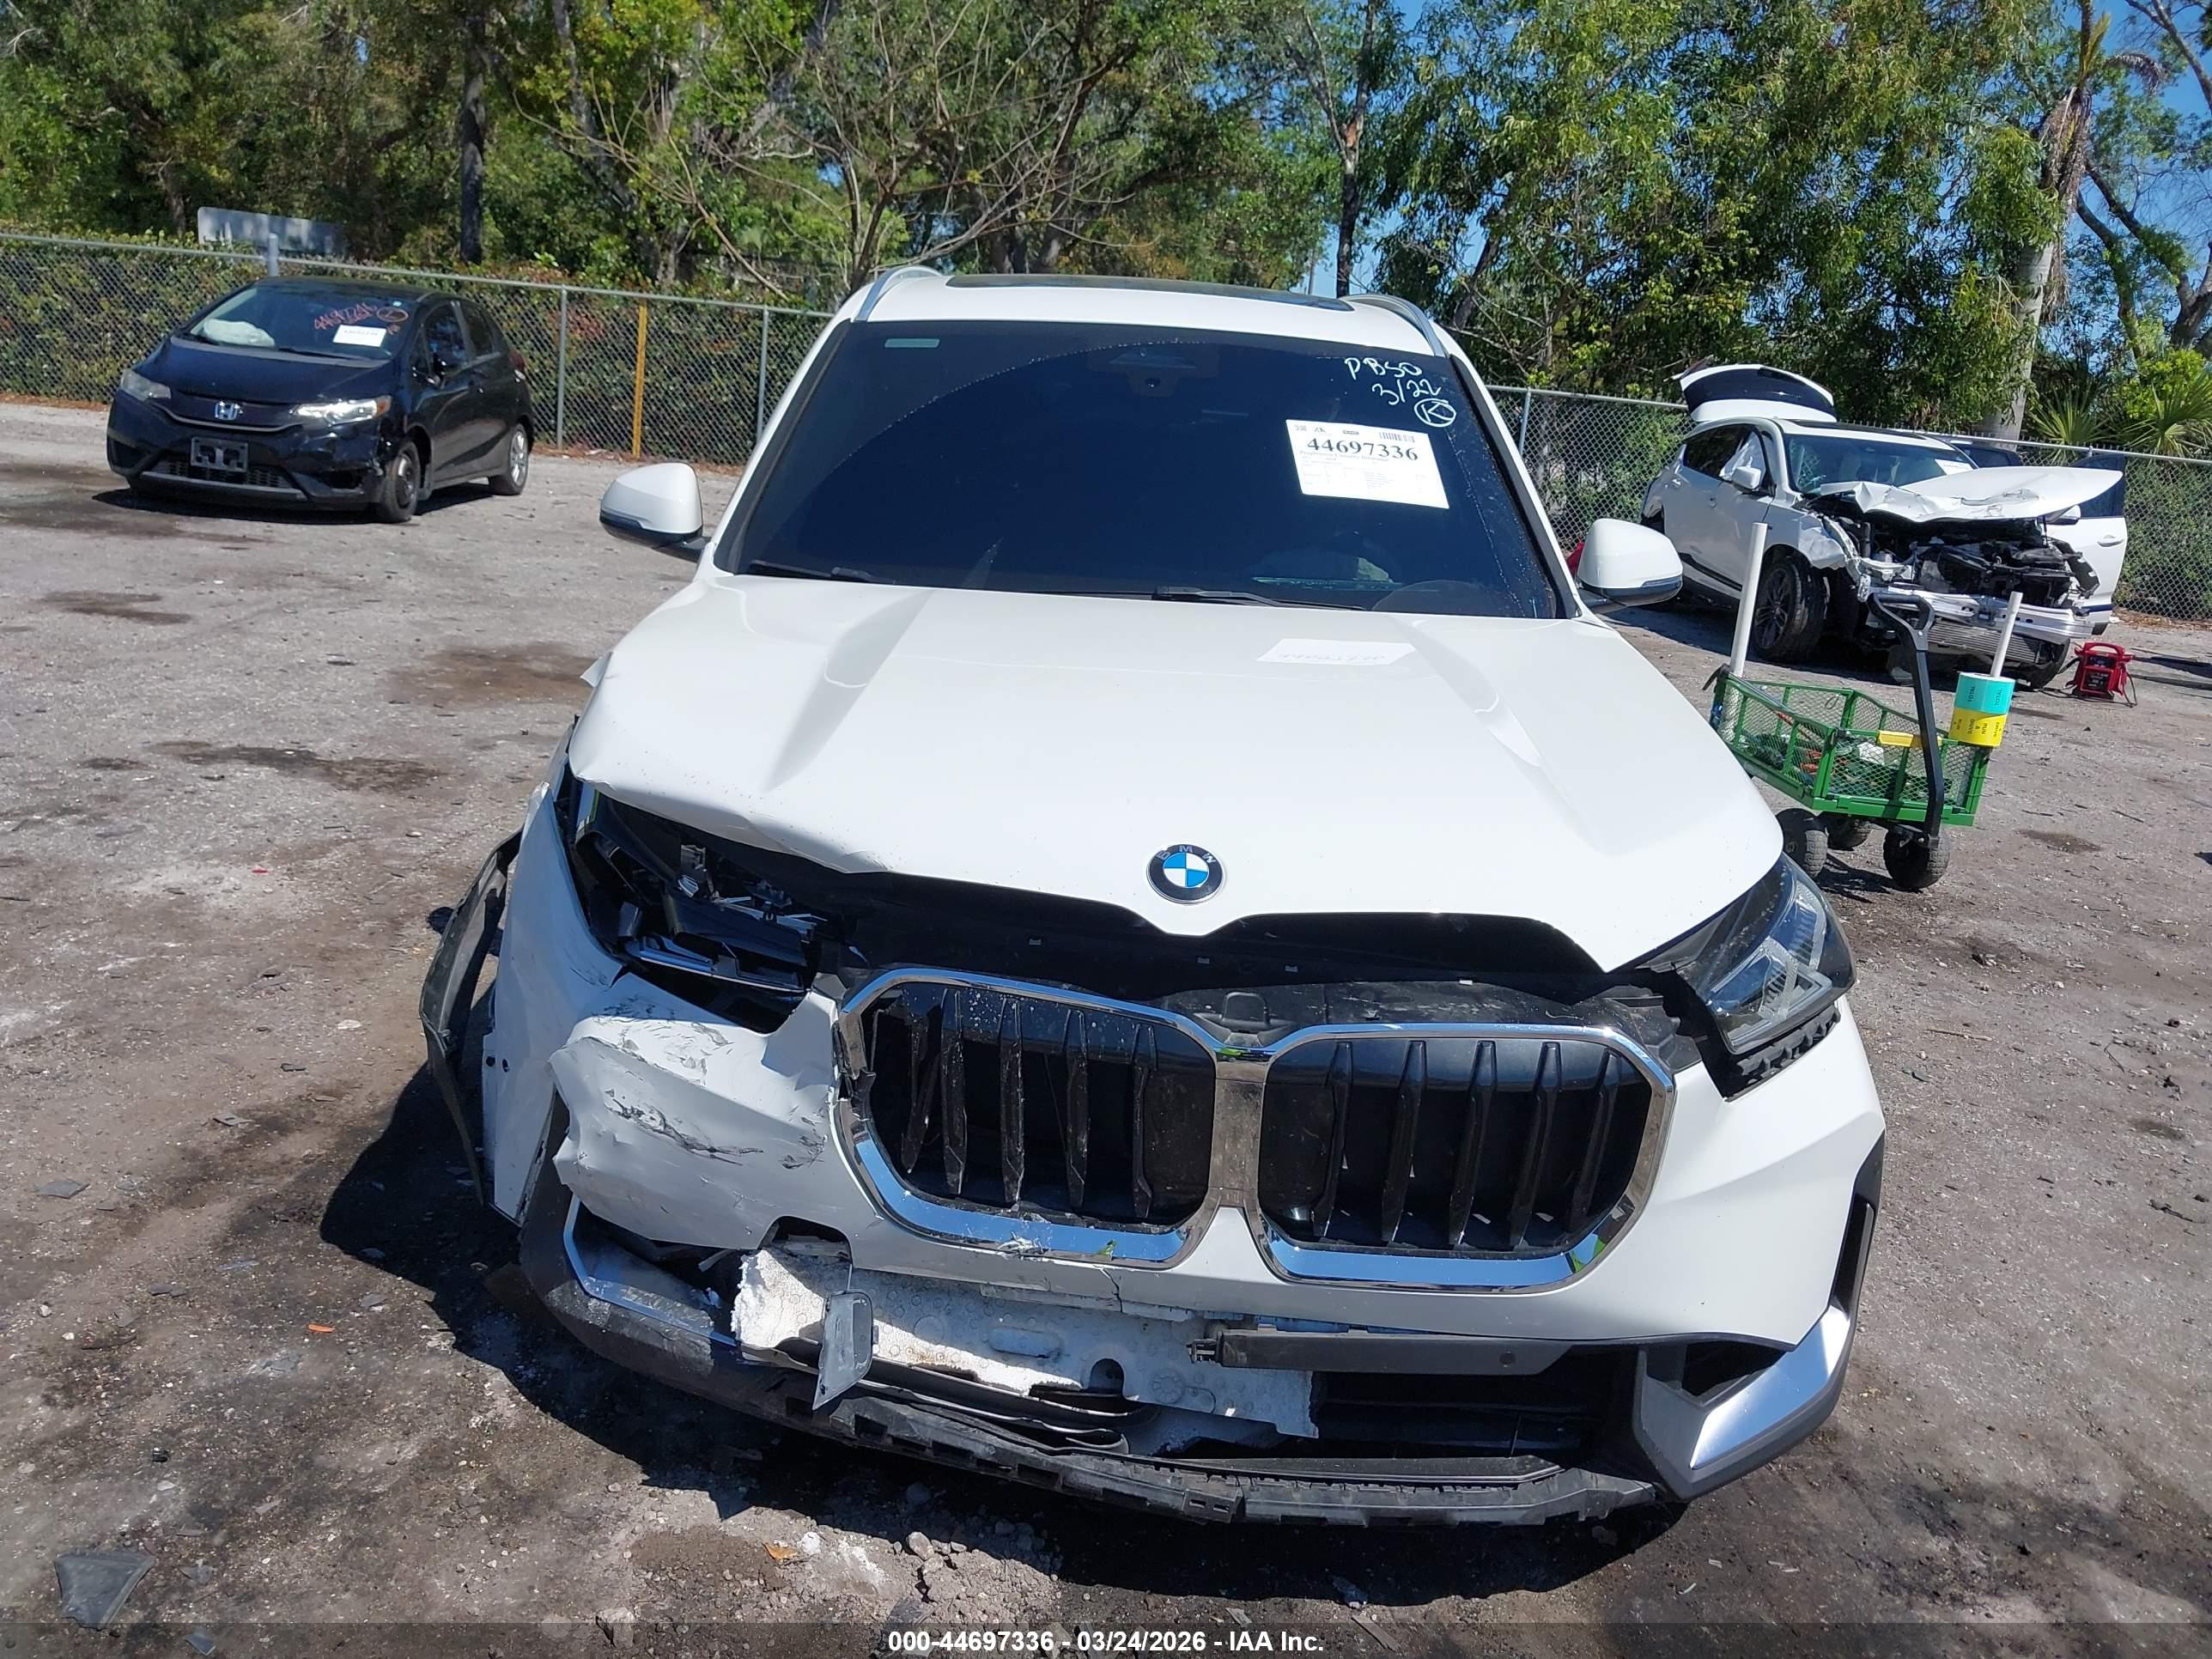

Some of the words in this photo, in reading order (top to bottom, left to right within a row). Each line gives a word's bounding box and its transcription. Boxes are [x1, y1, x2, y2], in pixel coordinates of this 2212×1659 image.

[1371, 379, 1442, 406] 3/22
[1307, 437, 1419, 461] 44697336
[1156, 845, 1217, 864] BMW
